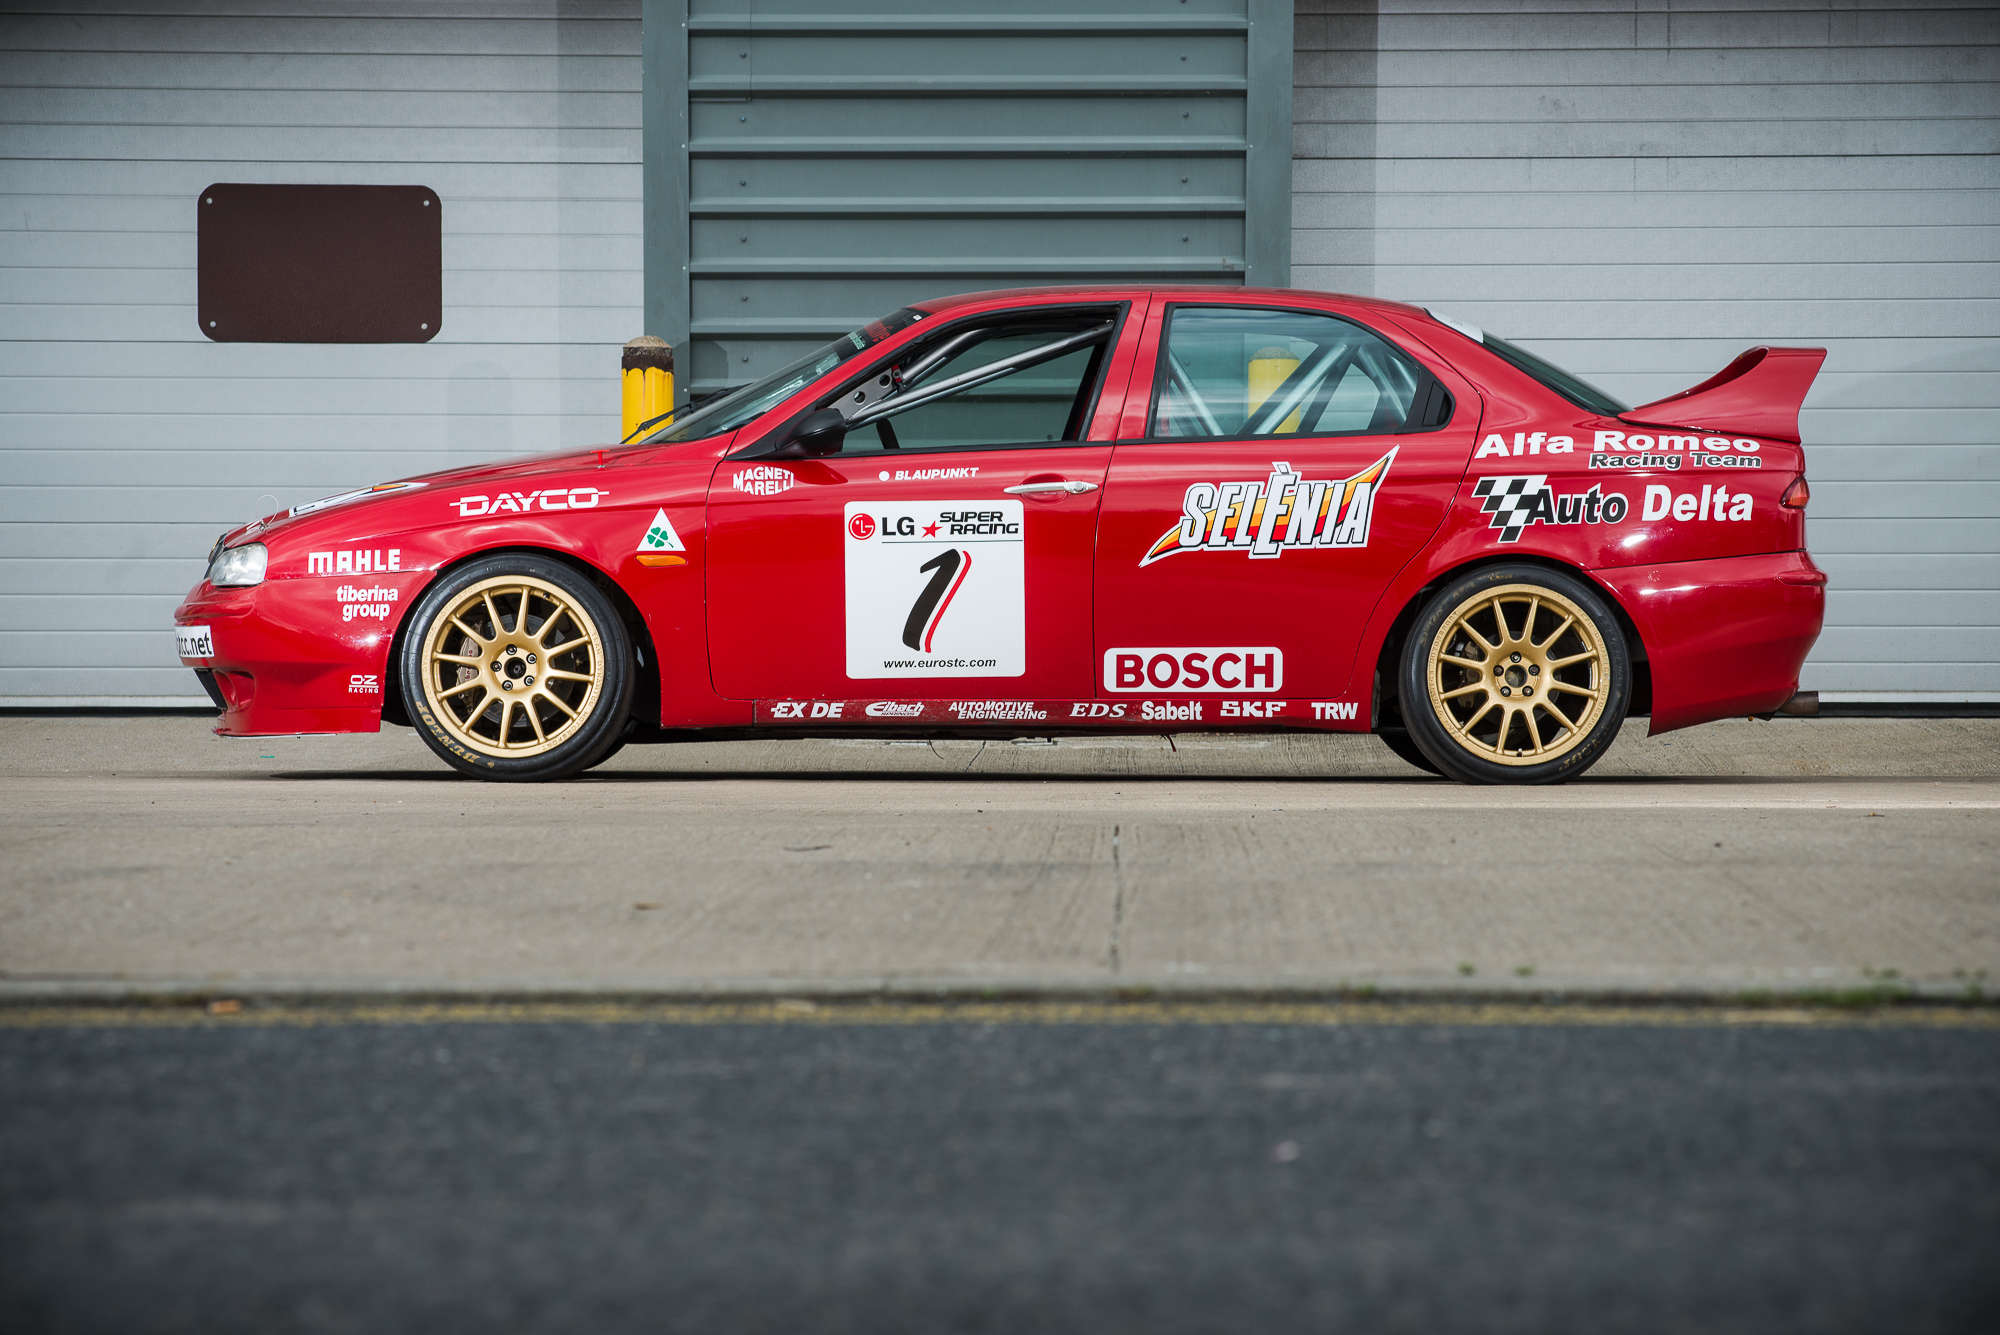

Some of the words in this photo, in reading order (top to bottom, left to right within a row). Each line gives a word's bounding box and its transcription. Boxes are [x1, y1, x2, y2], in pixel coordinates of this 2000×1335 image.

[1474, 432, 1575, 459] Alfa
[1594, 430, 1761, 453] Romeo
[1589, 452, 1682, 470] Racing
[1693, 452, 1762, 468] Team
[733, 466, 794, 484] MAGNETI
[895, 467, 980, 482] BLAUPUNKT
[733, 476, 794, 496] MARELLI
[450, 487, 610, 517] DAYCO
[1524, 484, 1628, 525] Auto
[1641, 484, 1754, 522] Delta
[883, 516, 915, 536] LG
[940, 511, 1004, 523] SUPER
[949, 523, 1020, 535] RACING
[308, 549, 401, 574] MAHLE
[336, 585, 399, 603] tiberina
[903, 548, 971, 654] 1
[342, 603, 391, 622] group
[883, 658, 997, 669] www.eurostc.com
[1115, 652, 1275, 689] BOSCH
[948, 701, 1034, 711] AUTOMOTIVE
[957, 709, 1048, 720] ENGINEERING
[1069, 702, 1128, 718] EDS
[1141, 700, 1203, 721] Sabelt
[1220, 701, 1287, 718] SKF
[1311, 702, 1359, 720] TRW
